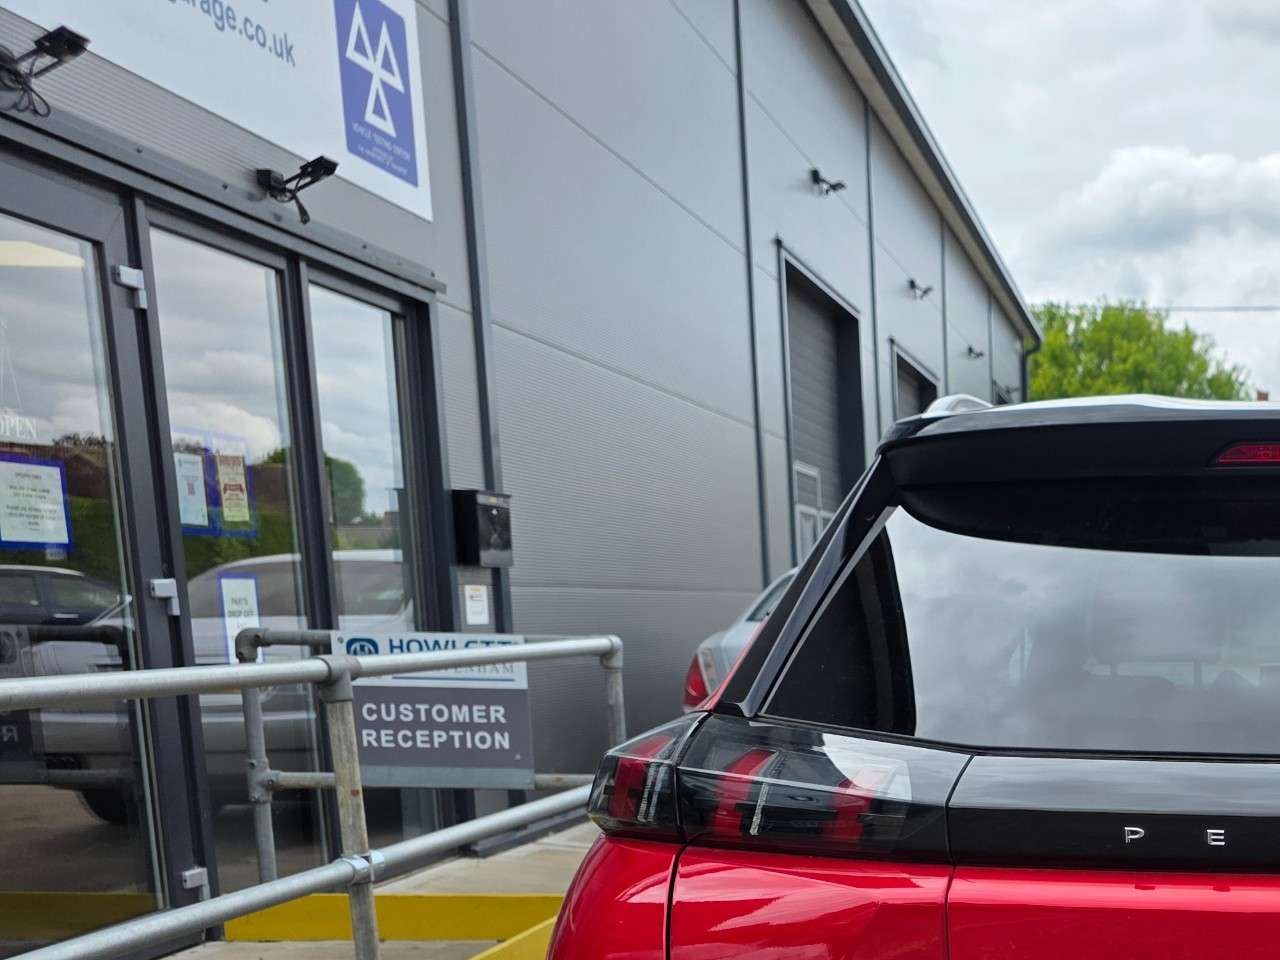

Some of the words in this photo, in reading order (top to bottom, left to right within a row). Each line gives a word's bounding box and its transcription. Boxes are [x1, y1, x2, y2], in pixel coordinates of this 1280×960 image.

[167, 0, 296, 67] age.co.uk
[362, 703, 507, 724] CUSTOMER
[362, 729, 511, 750] RECEPTION
